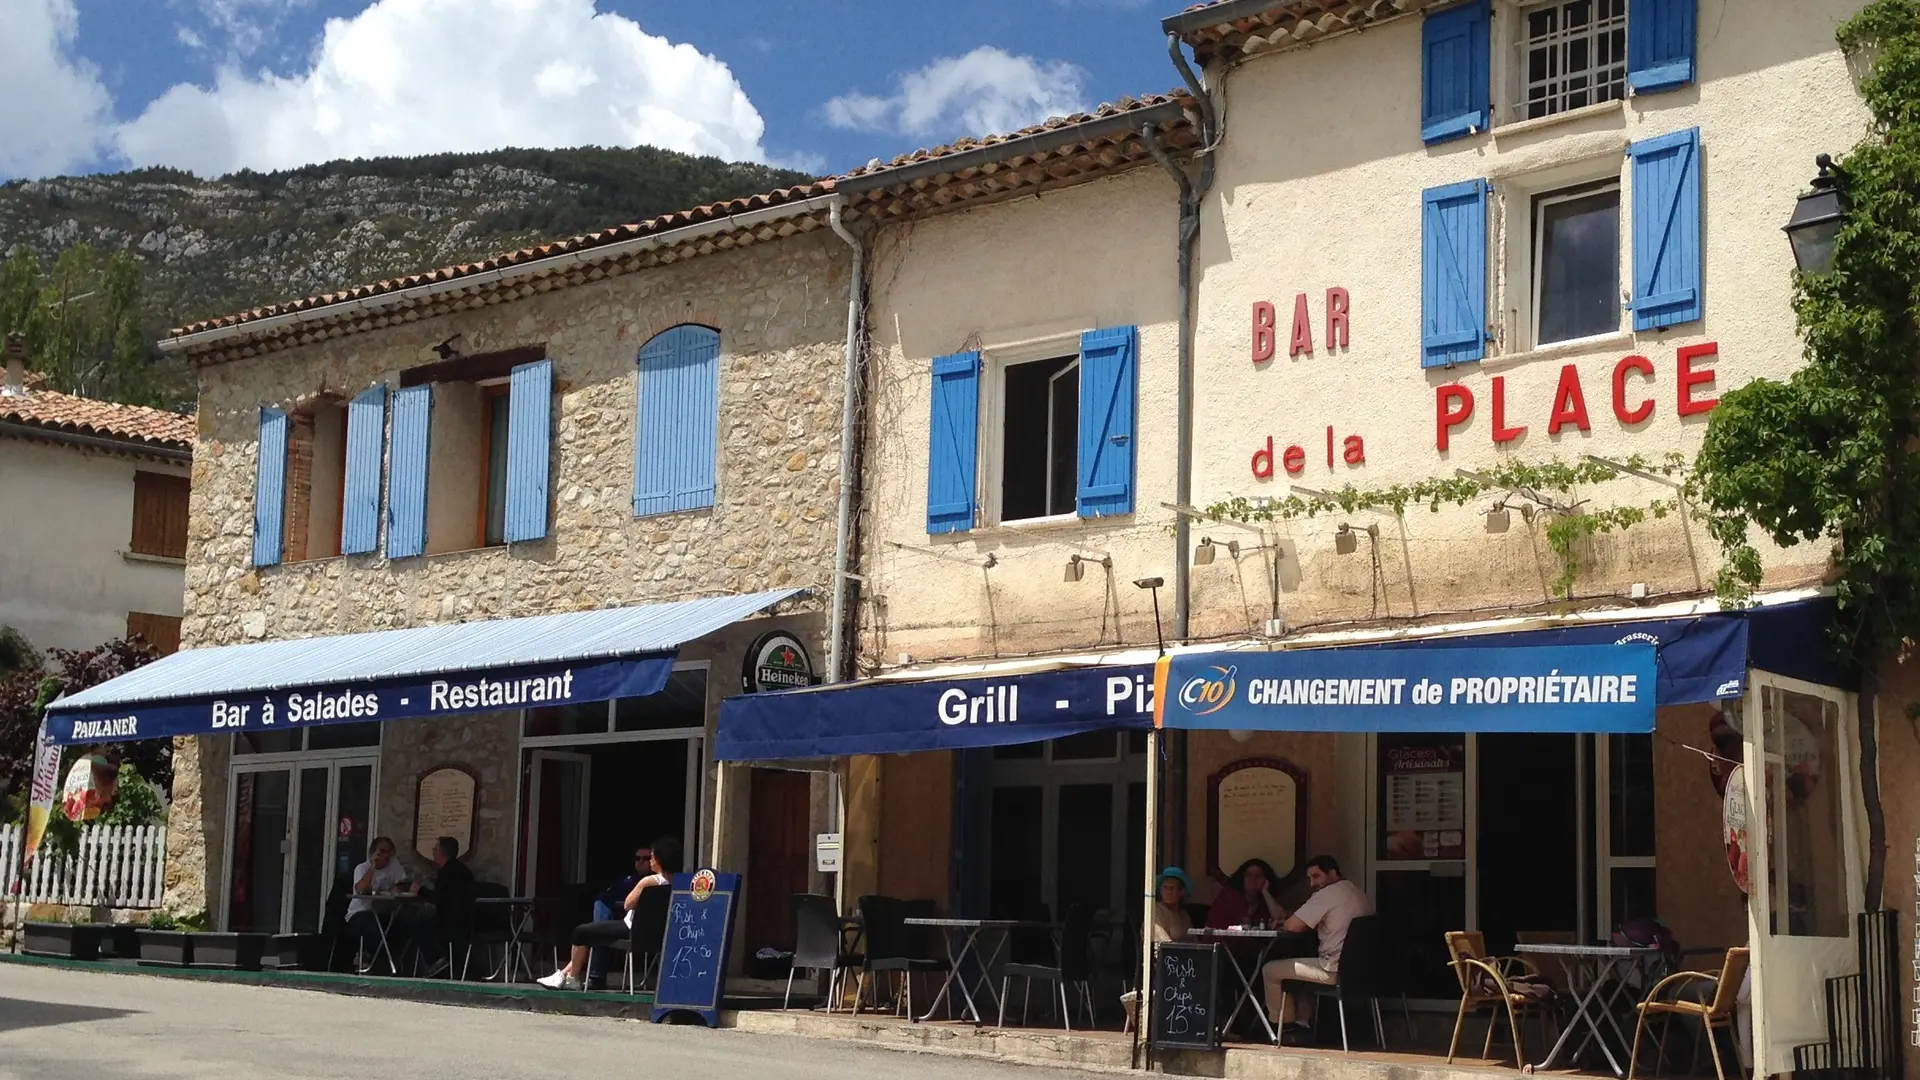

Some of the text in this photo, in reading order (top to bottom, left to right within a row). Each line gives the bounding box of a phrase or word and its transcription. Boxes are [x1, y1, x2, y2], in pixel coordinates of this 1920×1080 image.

[1252, 286, 1349, 363] BAR
[1251, 341, 1719, 477] de la PLACE
[761, 668, 809, 687] Heineken
[1183, 669, 1637, 705] C10 CHANGEMENT de PROPRIÉTAIRE
[212, 668, 573, 728] Bar à Salades - Restaurant
[938, 684, 1018, 725] Grill
[1055, 699, 1069, 709] -
[71, 715, 137, 740] PAULANER
[672, 902, 696, 923] Fish
[1164, 955, 1197, 978] Fish
[1164, 986, 1193, 1007] Chips
